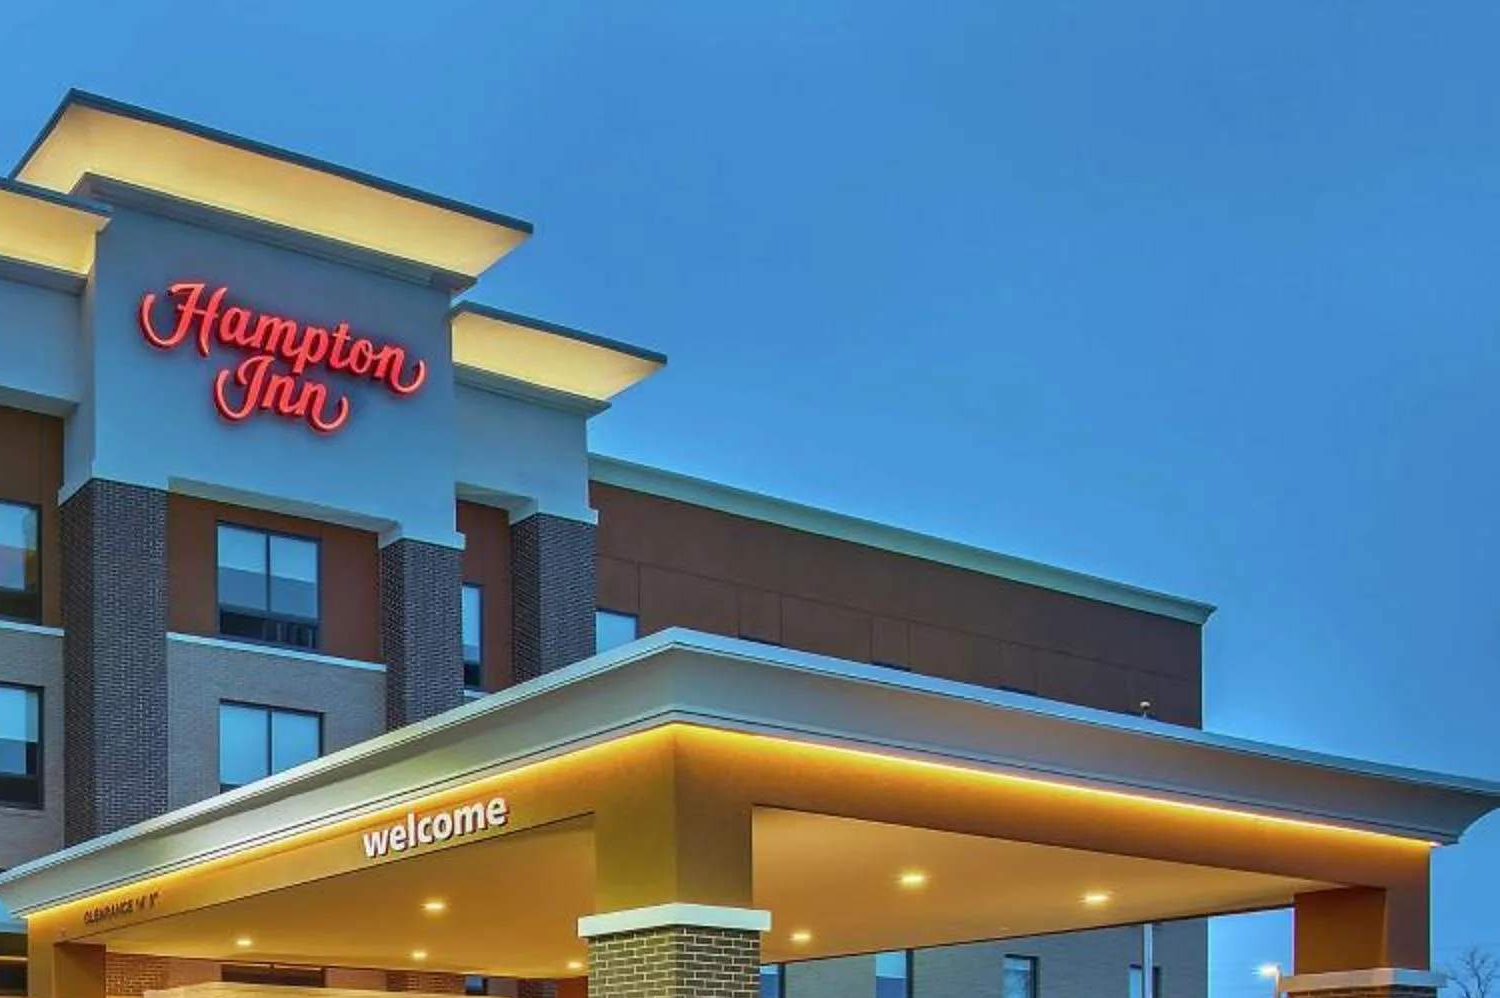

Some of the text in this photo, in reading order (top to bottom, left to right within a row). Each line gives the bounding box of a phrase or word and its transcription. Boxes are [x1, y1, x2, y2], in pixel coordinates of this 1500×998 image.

[139, 280, 427, 396] Hampton
[213, 355, 349, 435] Inn
[363, 797, 508, 859] welcome
